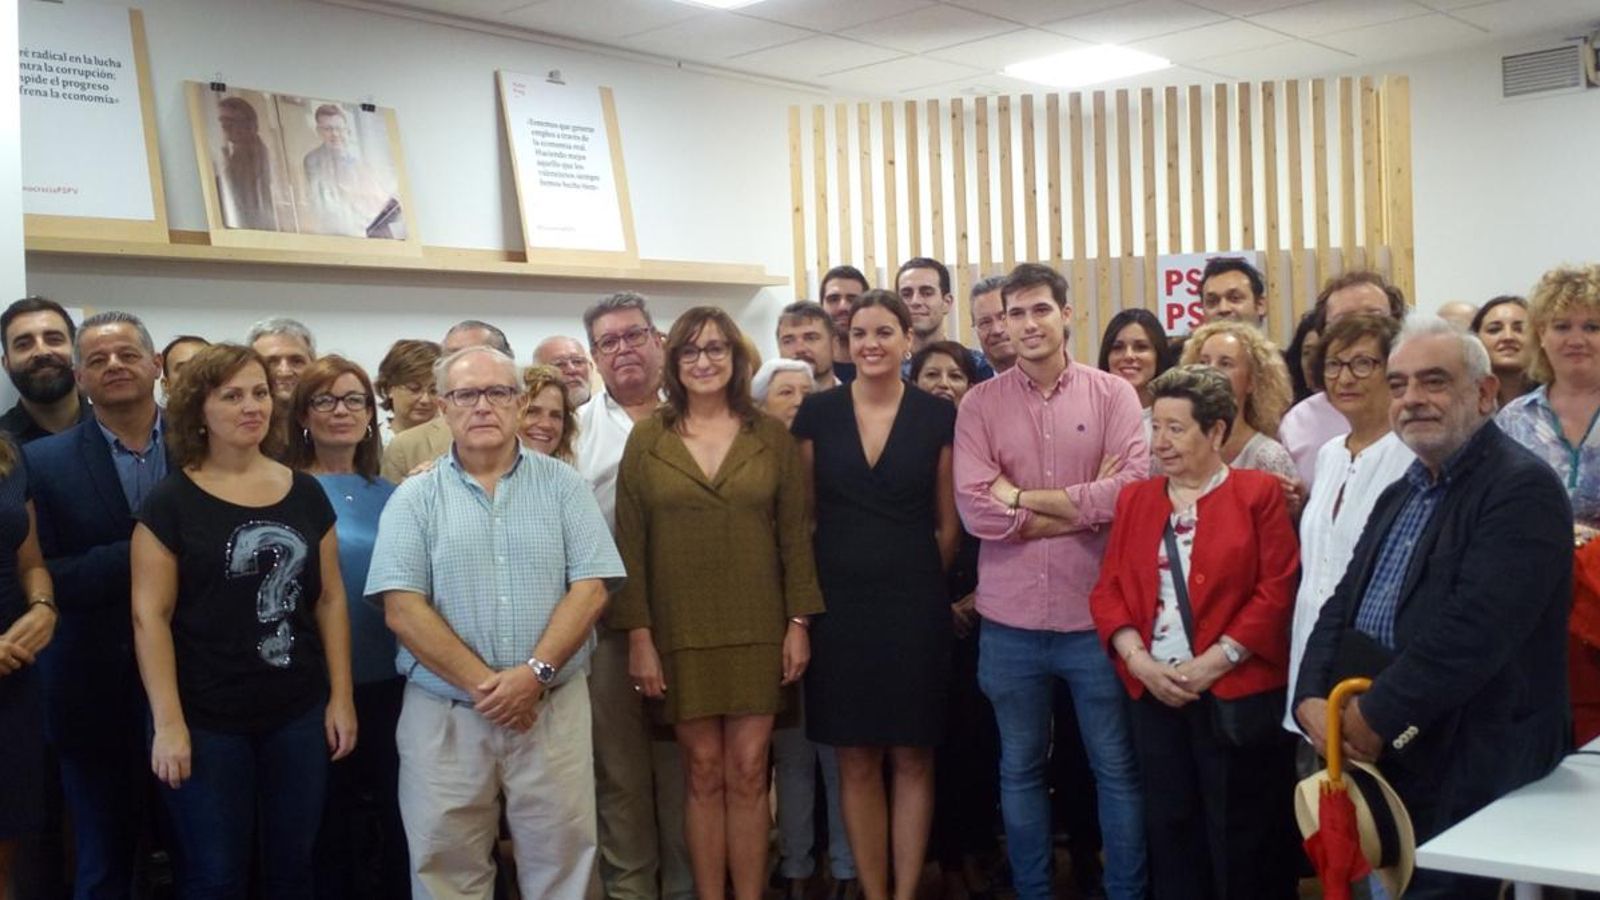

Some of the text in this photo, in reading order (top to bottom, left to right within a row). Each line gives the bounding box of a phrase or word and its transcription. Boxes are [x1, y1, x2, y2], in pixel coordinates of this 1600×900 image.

[32, 50, 67, 62] radical
[69, 55, 82, 64] en
[83, 54, 93, 65] la
[94, 56, 122, 69] lucha
[44, 62, 54, 73] la
[50, 77, 60, 87] el
[62, 80, 110, 92] progreso
[50, 88, 60, 99] la
